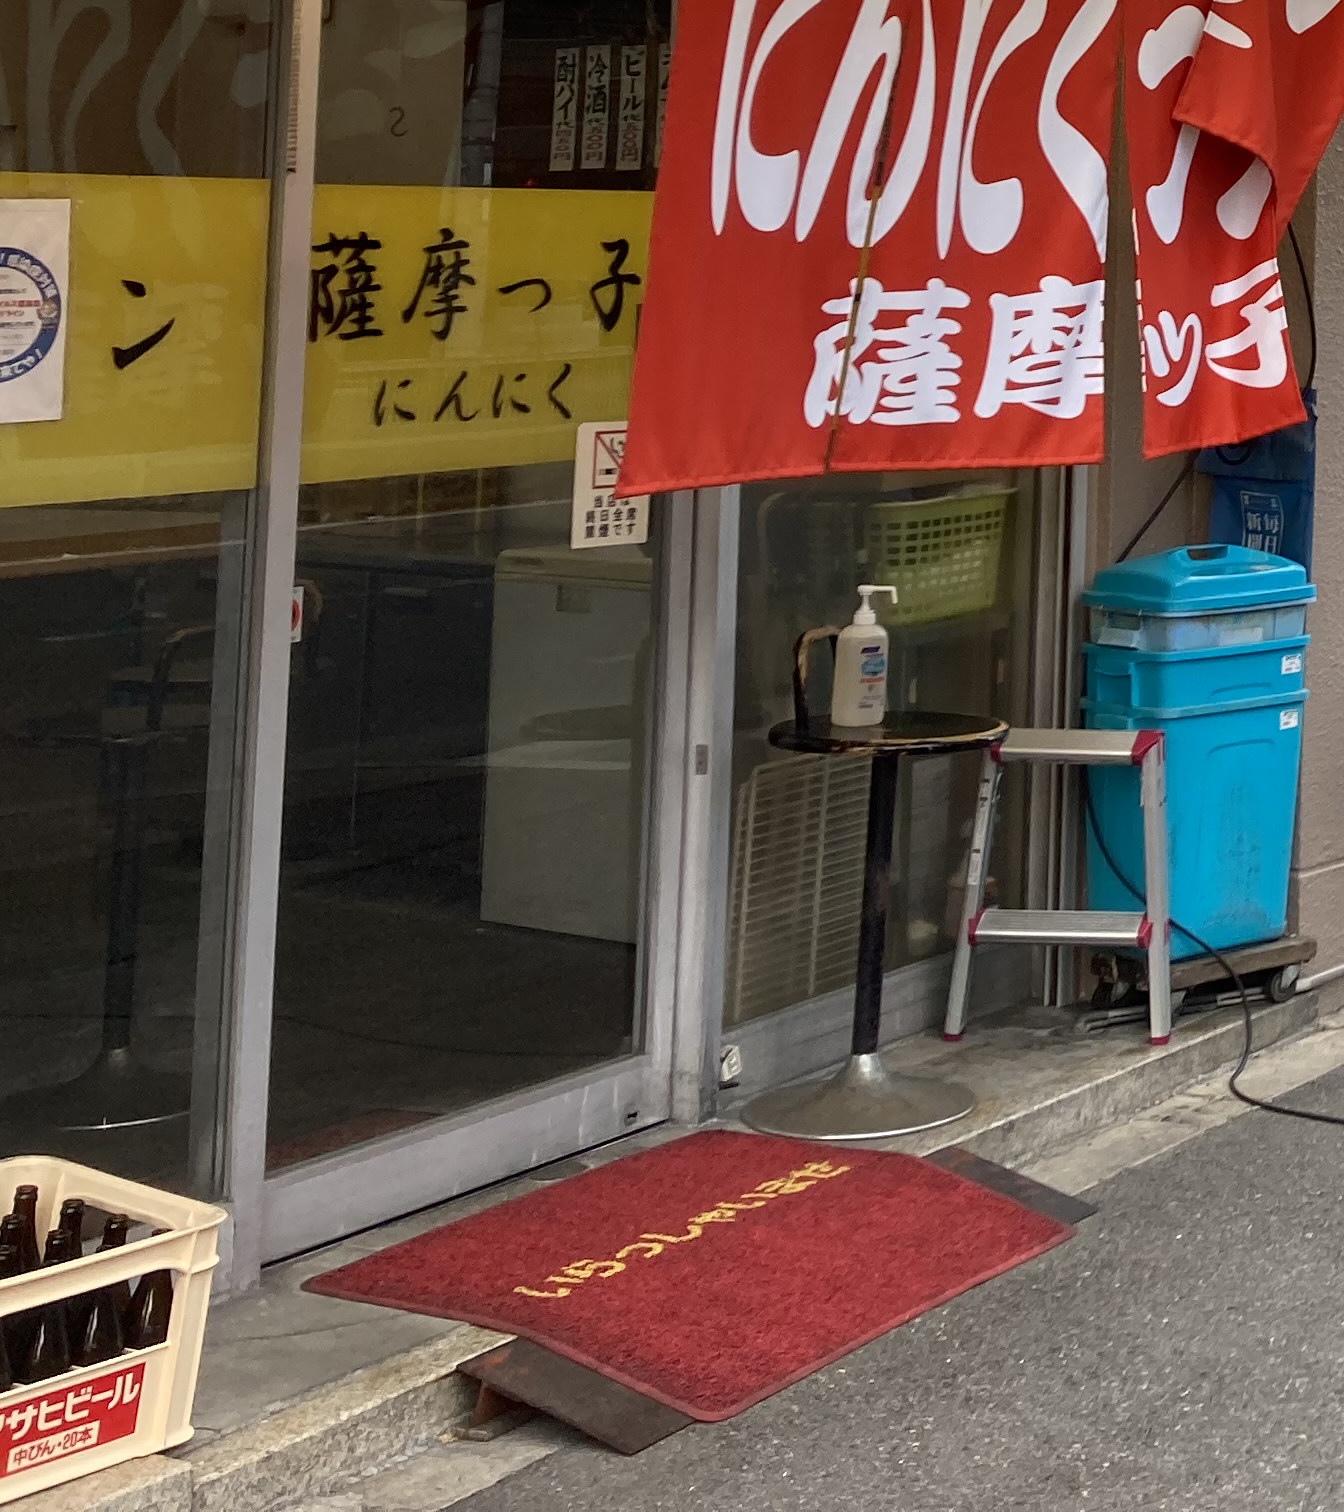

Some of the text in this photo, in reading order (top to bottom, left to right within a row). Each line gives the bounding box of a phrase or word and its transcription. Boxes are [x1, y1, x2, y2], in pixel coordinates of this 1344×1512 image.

[308, 227, 644, 343] 薩摩っ子
[372, 361, 574, 428] にんにく
[512, 1159, 852, 1299] いらっしゃいませ
[0, 1371, 141, 1443] サヒビール
[13, 1426, 94, 1466] 中びん・20本
